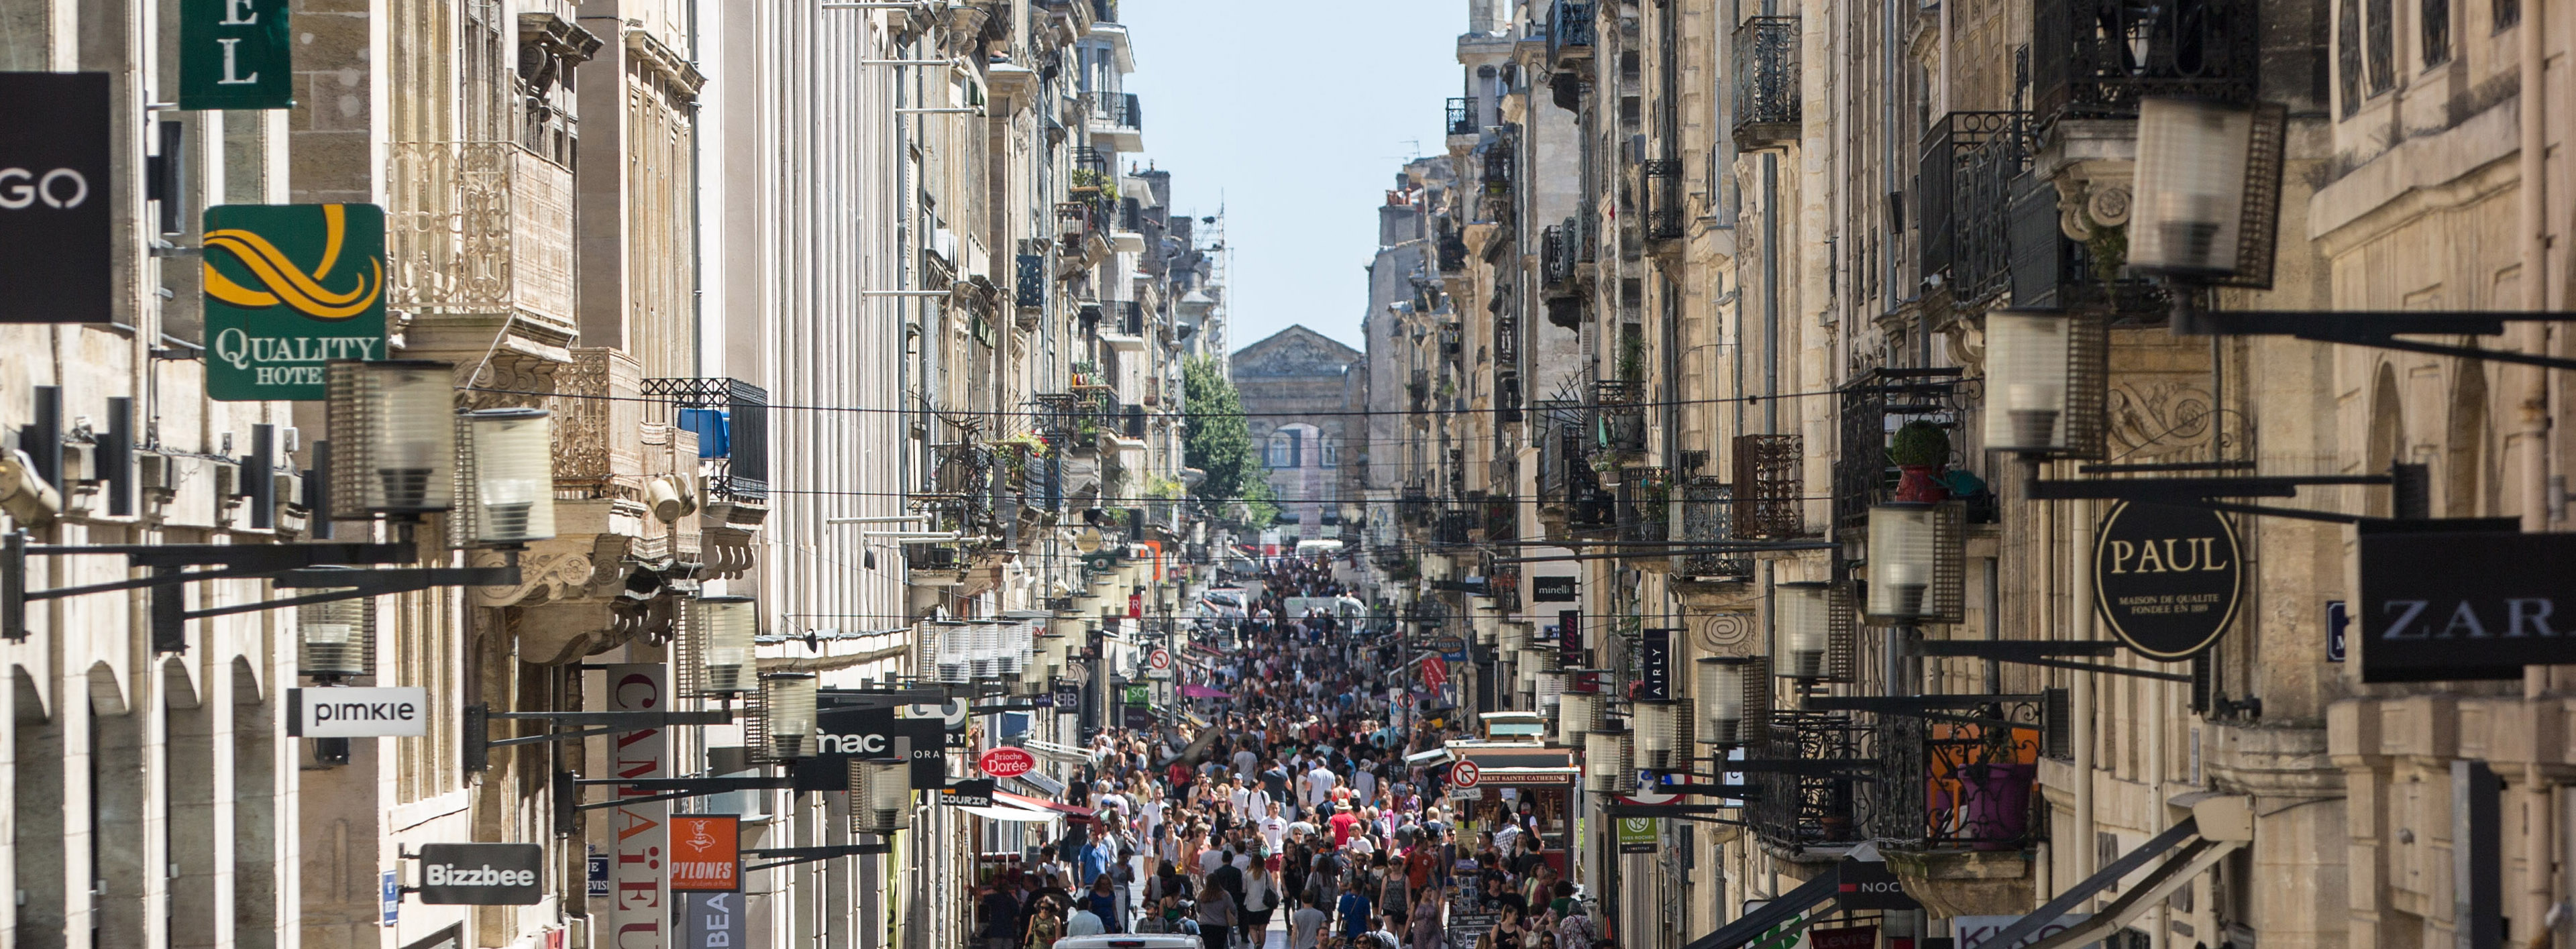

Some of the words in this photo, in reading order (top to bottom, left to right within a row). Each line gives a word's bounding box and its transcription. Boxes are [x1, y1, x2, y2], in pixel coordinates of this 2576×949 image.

[0, 168, 88, 209] GO
[215, 328, 379, 370] QUALITY
[255, 367, 327, 385] HOTE
[2110, 538, 2227, 573] PAUL
[1538, 585, 1570, 594] minelli
[2119, 596, 2157, 605] MAISON
[2160, 595, 2174, 604] DE
[2174, 605, 2188, 613] EN
[2383, 598, 2576, 640] ZAR
[1652, 649, 1662, 695] AIRLY
[315, 703, 415, 726] pimkie
[910, 750, 940, 759] ORA
[987, 759, 1028, 772] Dorée
[941, 795, 988, 805] COURIR
[426, 863, 535, 887] Bizzbee
[671, 862, 733, 879] PYLONES
[1862, 882, 1904, 893] NOC
